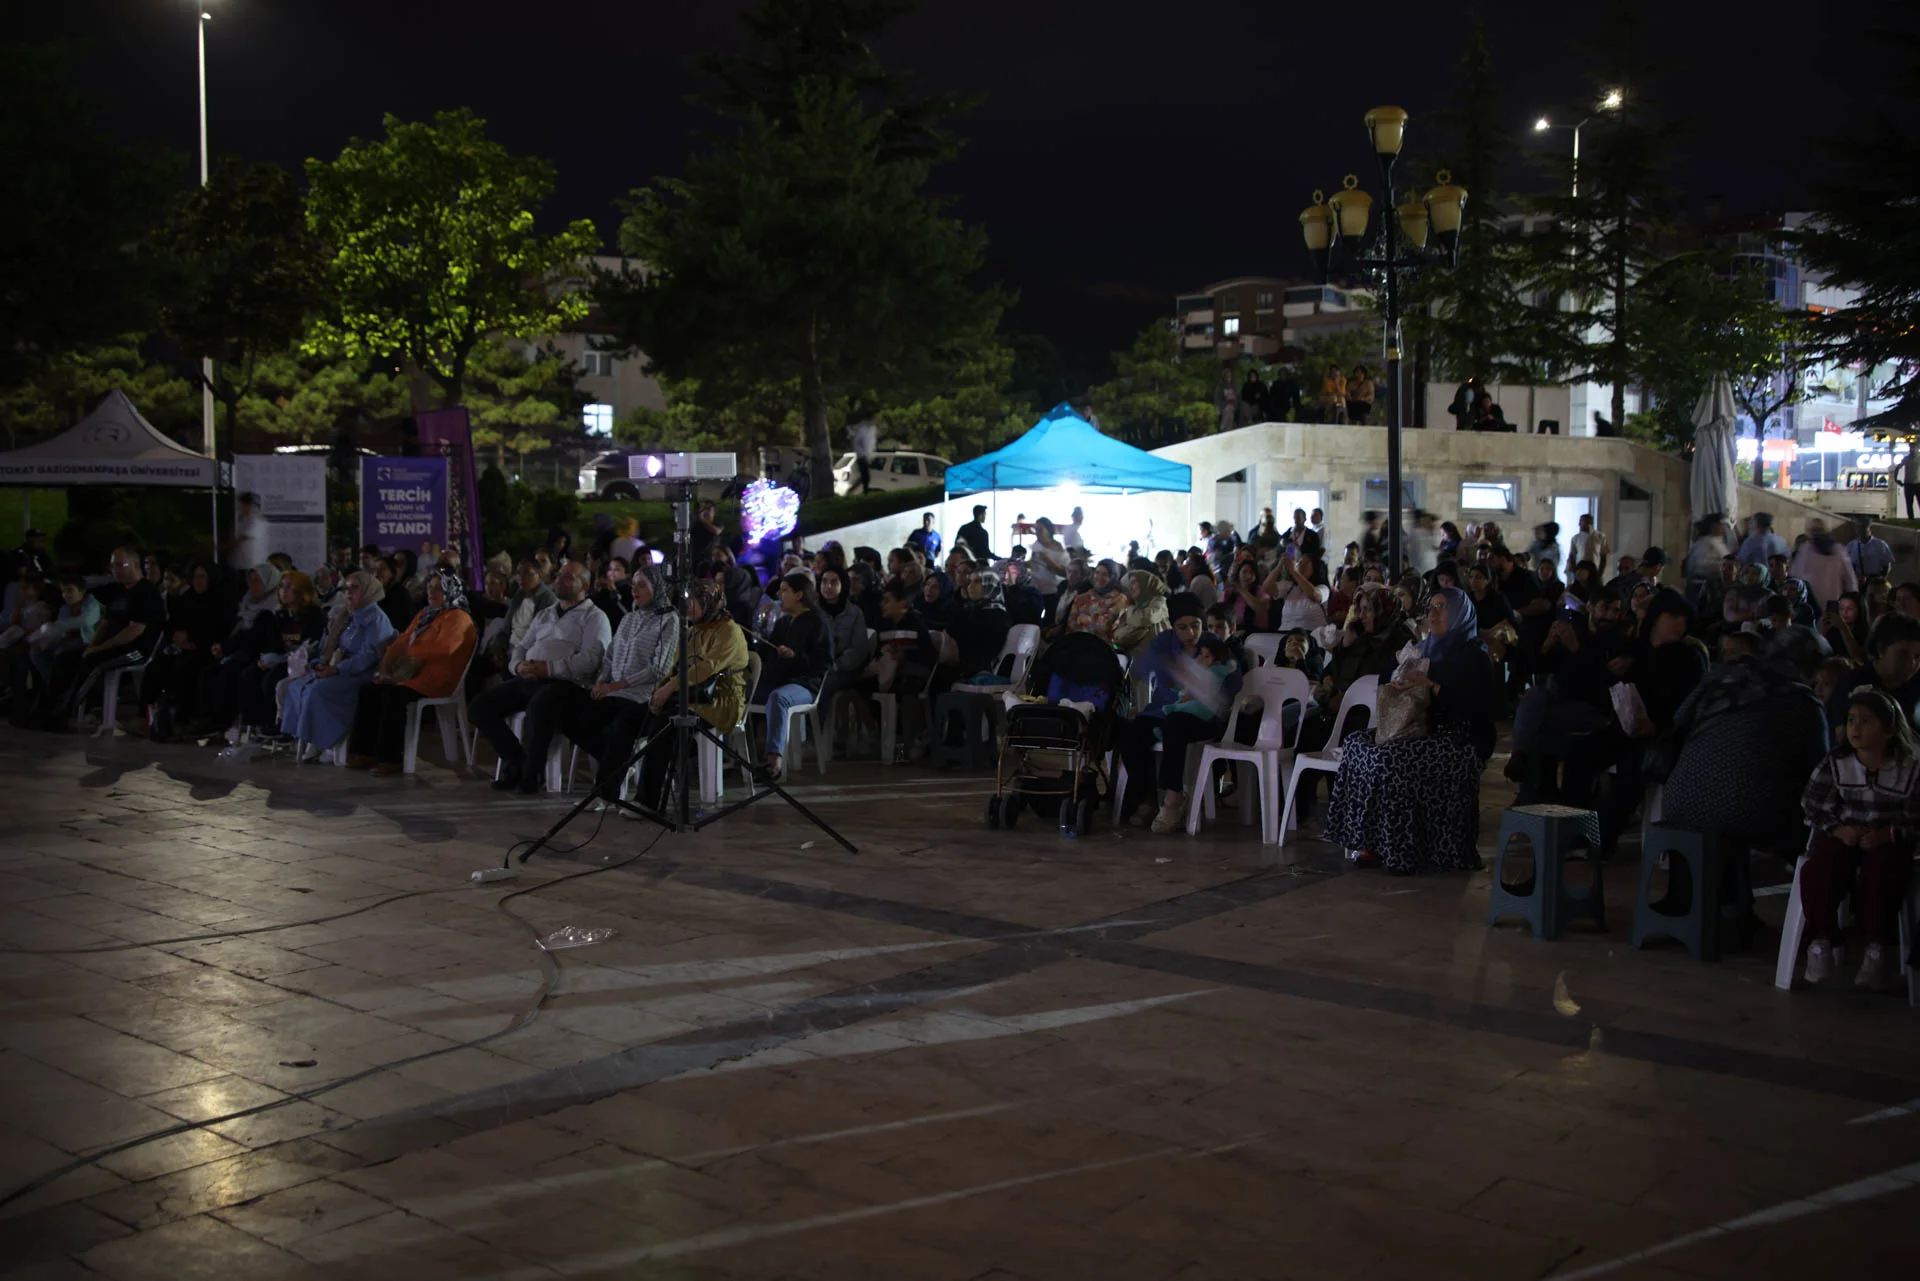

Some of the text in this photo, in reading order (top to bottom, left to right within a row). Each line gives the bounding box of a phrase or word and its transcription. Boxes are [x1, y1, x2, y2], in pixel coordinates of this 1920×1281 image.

[0, 465, 34, 474] TOKAT
[378, 486, 431, 502] TERCİH
[378, 522, 431, 535] STANDI
